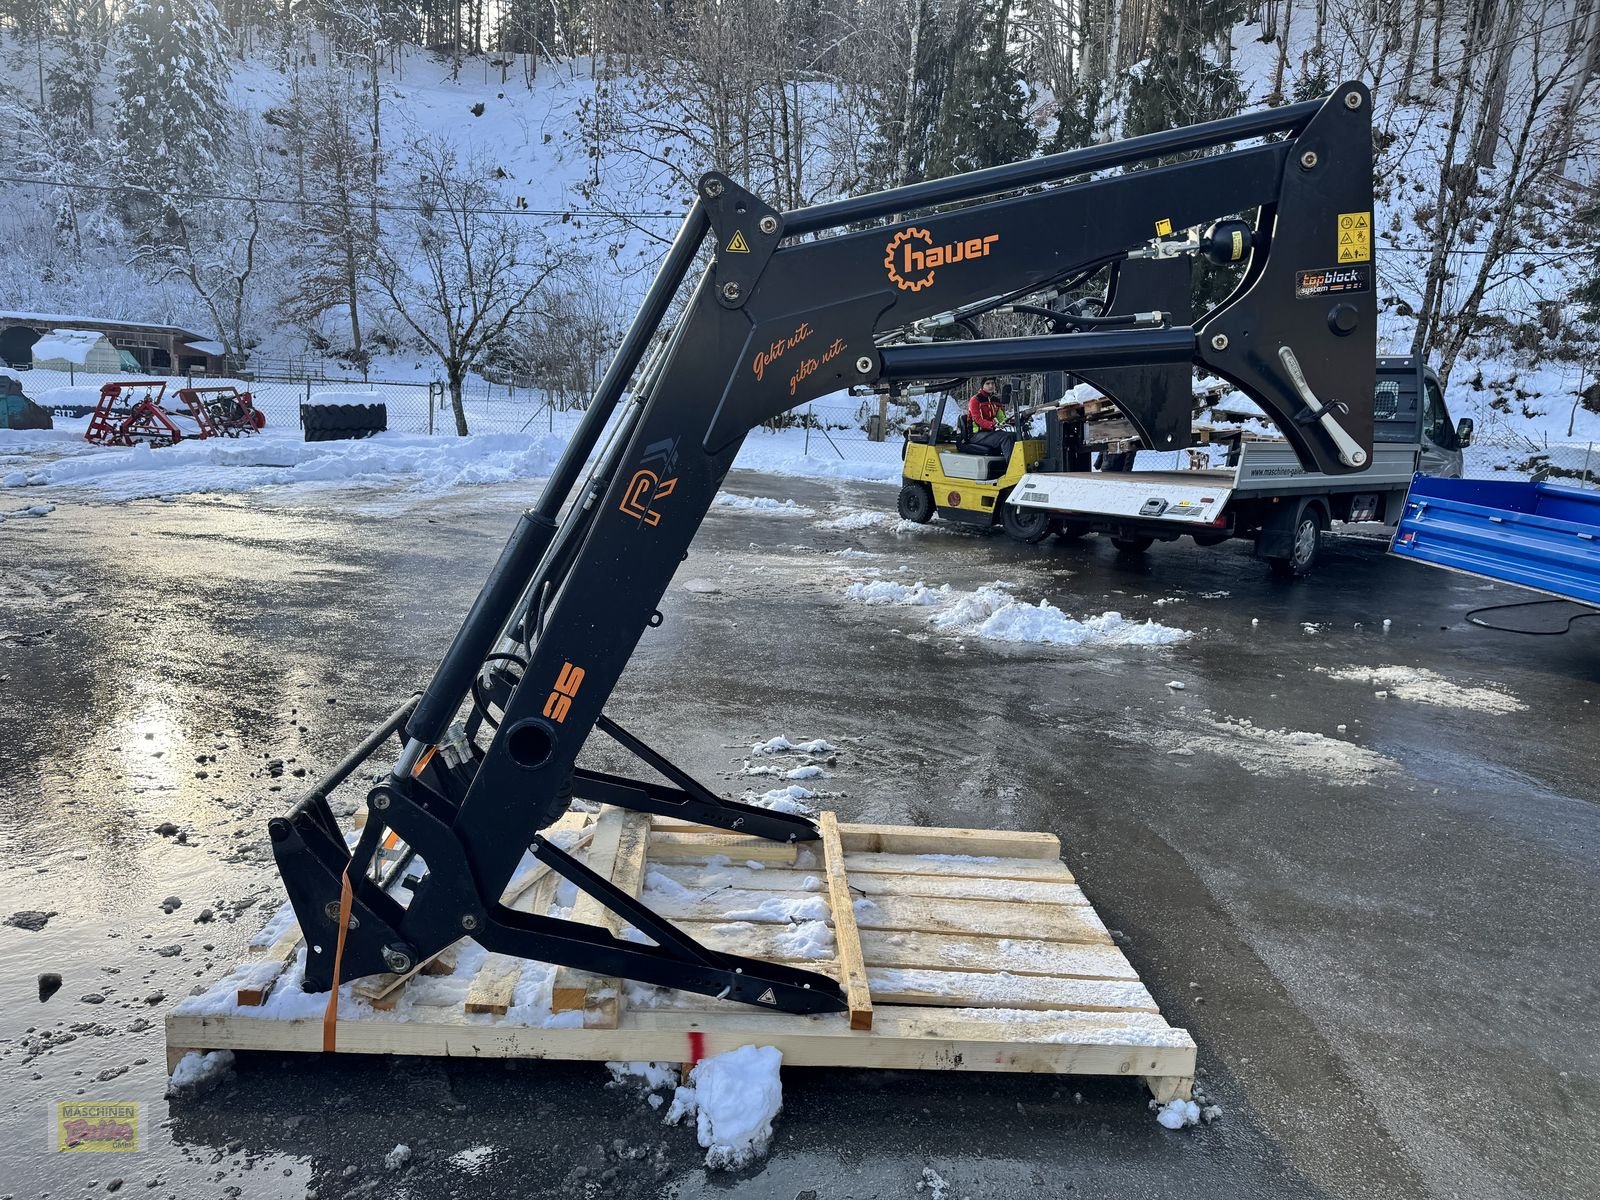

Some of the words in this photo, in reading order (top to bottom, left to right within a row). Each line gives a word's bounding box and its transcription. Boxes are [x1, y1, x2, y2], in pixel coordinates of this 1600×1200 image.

[904, 234, 999, 273] hauer
[1301, 285, 1329, 295] system
[1303, 269, 1359, 287] topblock
[753, 339, 786, 381] Geht
[790, 358, 819, 396] gibts
[542, 661, 586, 724] S5
